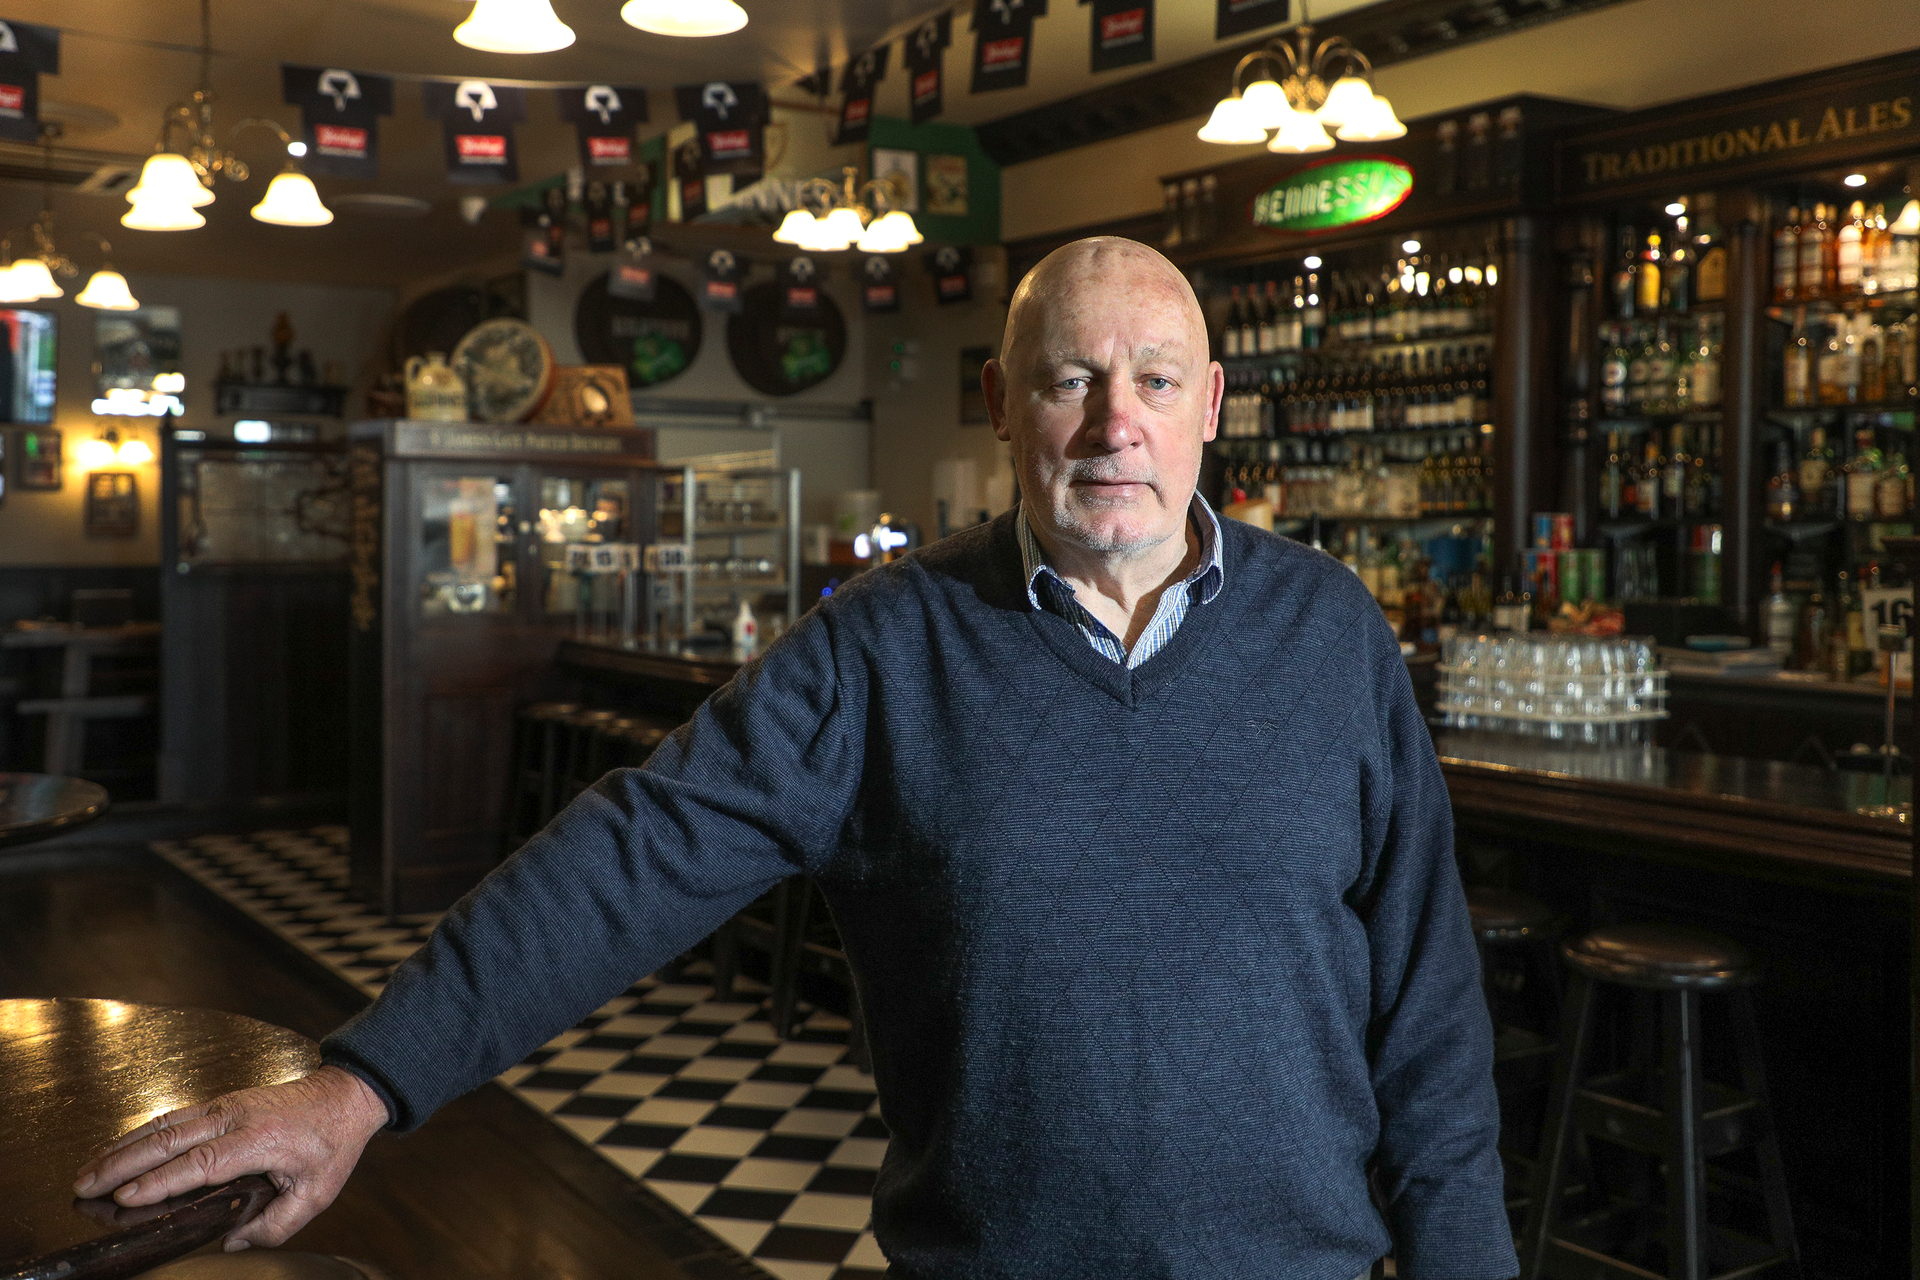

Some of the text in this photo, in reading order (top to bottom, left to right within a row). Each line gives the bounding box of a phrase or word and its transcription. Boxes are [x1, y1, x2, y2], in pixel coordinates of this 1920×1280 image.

[1583, 96, 1912, 184] TRADITIONAL ALES
[1871, 599, 1914, 638] 16
